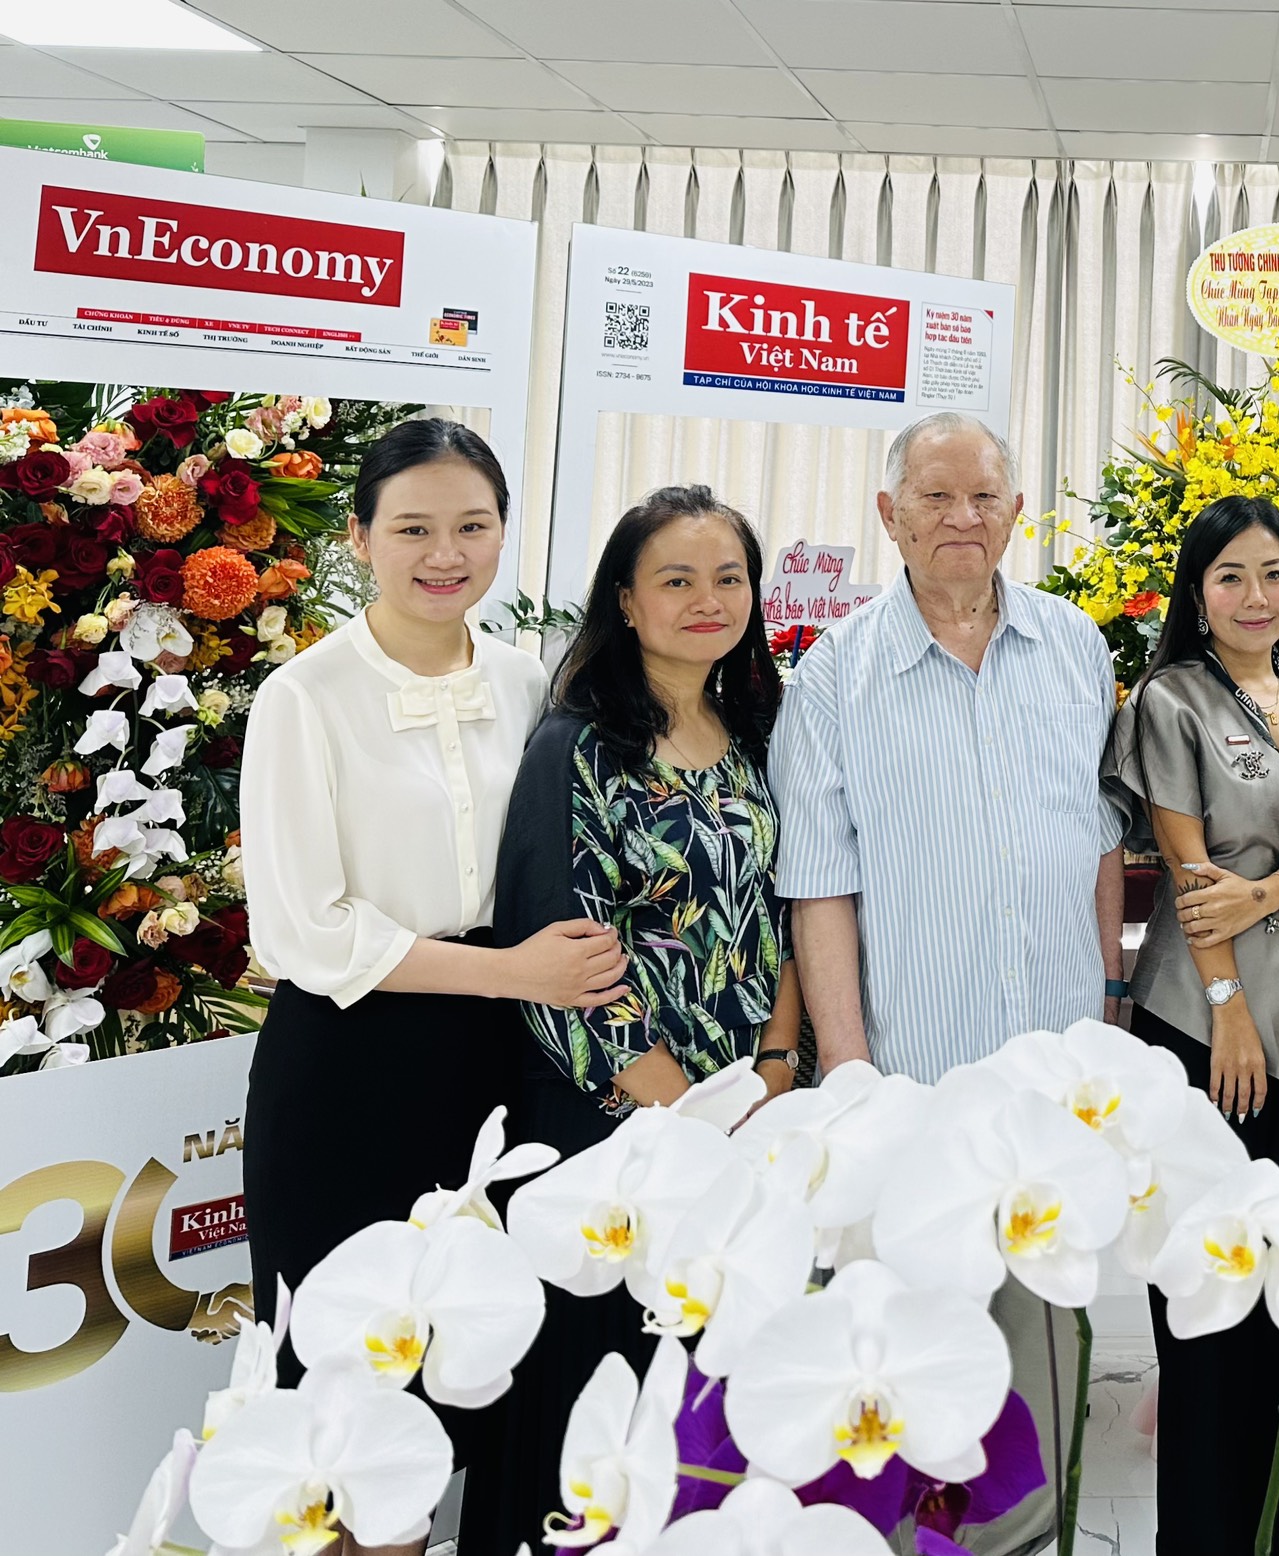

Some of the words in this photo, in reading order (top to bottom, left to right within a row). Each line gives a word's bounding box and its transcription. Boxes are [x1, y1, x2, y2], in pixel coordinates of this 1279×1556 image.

[52, 205, 394, 298] VnEconomy
[1209, 245, 1225, 272] THỦ
[1228, 246, 1255, 272] TƯỚNG
[617, 266, 630, 275] 22
[1200, 279, 1225, 300] Chúc
[1229, 279, 1255, 304] Mừng
[1259, 280, 1279, 304] Tạp
[701, 290, 833, 343] Kinh
[844, 306, 897, 349] tế
[951, 311, 959, 321] 30
[137, 328, 157, 336] KINH
[270, 339, 296, 348] DOANH
[281, 327, 309, 335] CONNECT
[322, 331, 348, 339] ENGLISH
[739, 341, 794, 373] Việt
[799, 347, 859, 374] Nam
[615, 371, 631, 379] 2734
[693, 375, 712, 386] TẠP
[715, 375, 731, 387] CHÍ
[734, 377, 753, 389] CỦA
[755, 379, 772, 391] HỘI
[774, 382, 799, 392] KHOA
[801, 384, 820, 395] HỌC
[822, 386, 842, 396] KINH
[844, 386, 857, 397] TẾ
[858, 387, 877, 399] VIỆT
[878, 391, 897, 400] NAM
[782, 541, 809, 574] Chúc
[813, 551, 844, 592] Mừng
[763, 586, 783, 621] Nhà
[785, 581, 804, 620] báo
[807, 595, 826, 622] Việt
[827, 596, 850, 619] Nam
[182, 1117, 245, 1163] NĂ
[180, 1201, 245, 1233] Kinh
[198, 1226, 225, 1240] Việt
[228, 1221, 247, 1234] Na
[182, 1244, 212, 1256] VIETNAM
